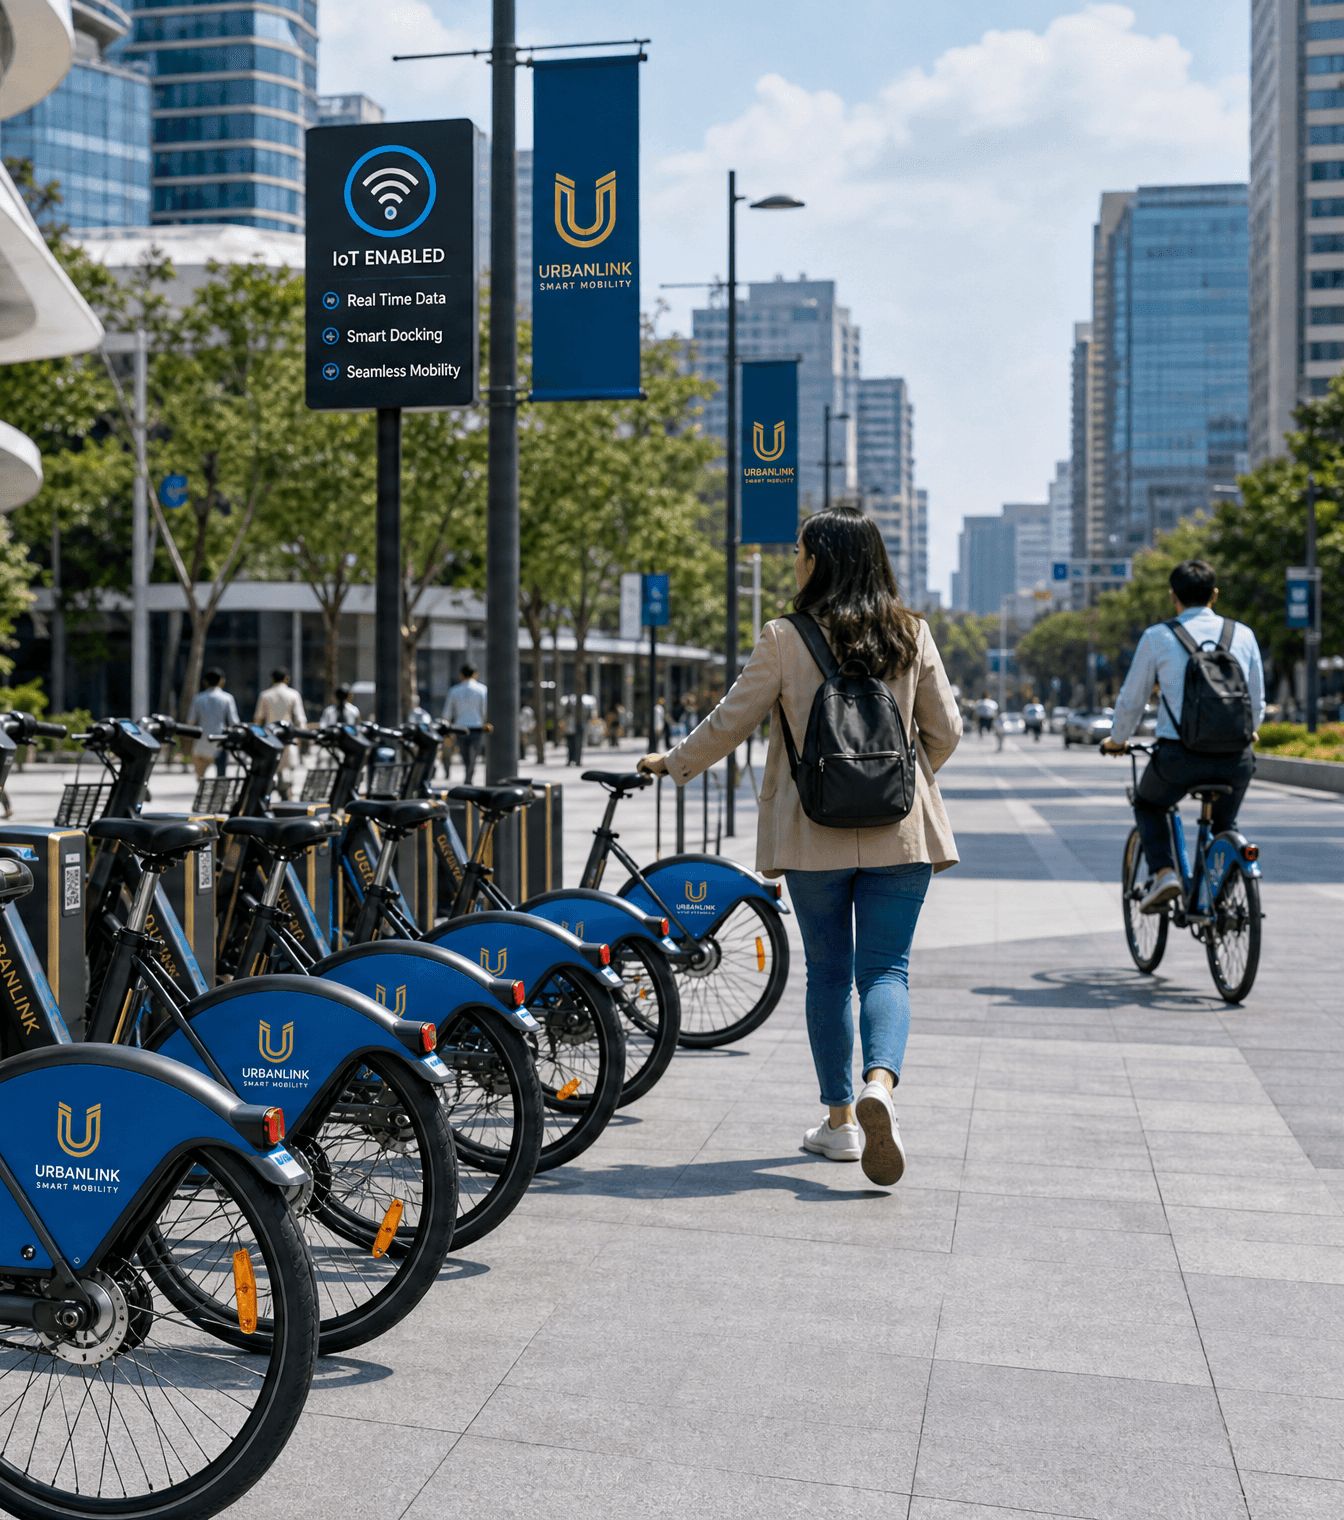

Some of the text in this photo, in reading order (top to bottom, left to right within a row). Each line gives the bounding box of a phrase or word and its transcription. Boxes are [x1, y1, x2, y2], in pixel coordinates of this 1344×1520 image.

[332, 248, 445, 267] IoT ENABLED
[538, 262, 632, 278] URBANLINK
[539, 280, 632, 291] SMART MOBILITY
[347, 291, 446, 307] Real Time Data
[347, 327, 443, 344] Smart Docking
[346, 362, 461, 379] Seamless Mobility
[743, 467, 795, 477] URBANLINK
[242, 1067, 310, 1080] URBANLINK
[35, 1164, 120, 1182] URBANLINK
[36, 1181, 119, 1194] SMART MOBILITY
